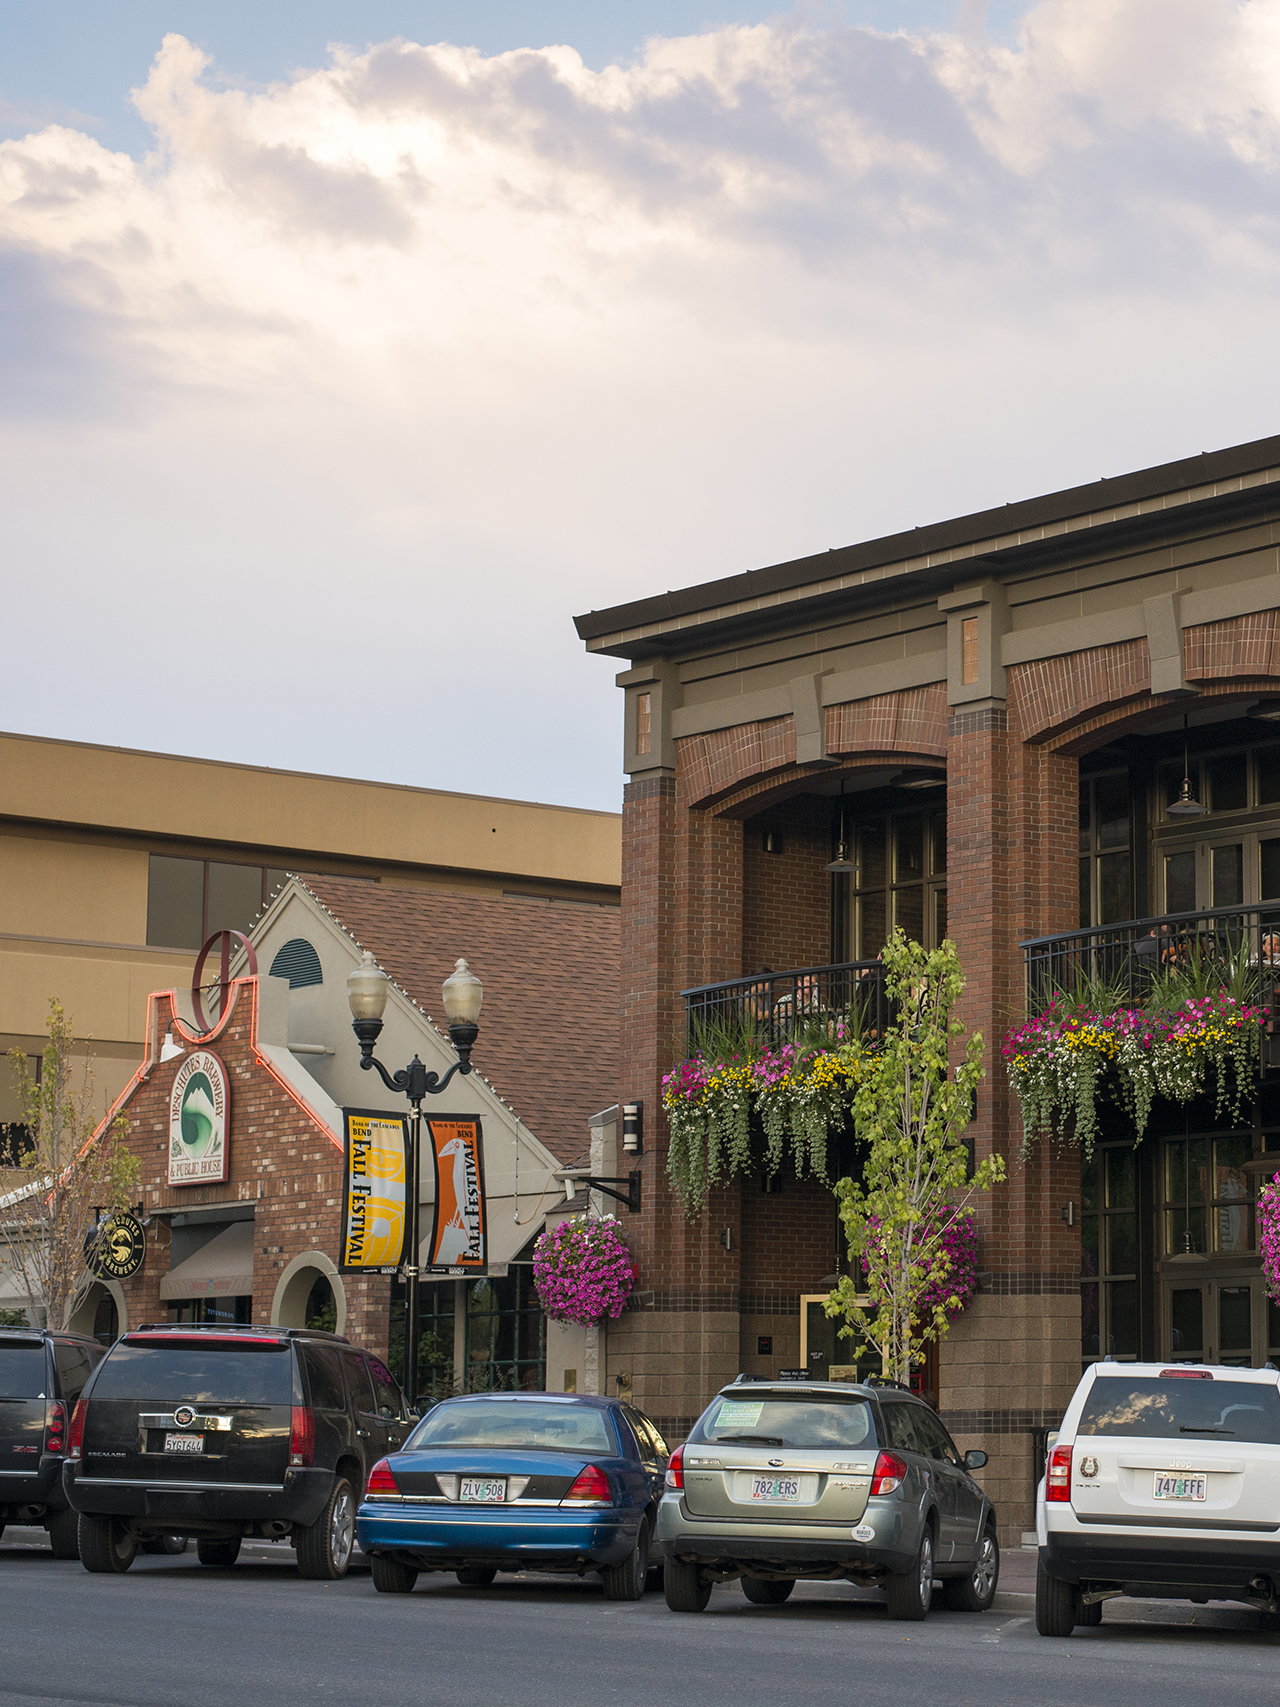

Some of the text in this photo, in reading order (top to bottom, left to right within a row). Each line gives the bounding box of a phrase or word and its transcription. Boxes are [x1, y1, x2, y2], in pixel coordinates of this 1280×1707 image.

[172, 1055, 223, 1121] DESCHUTES BREWERY
[353, 1128, 371, 1136] BEND
[457, 1130, 473, 1138] BEND
[170, 1159, 221, 1177] & PUBLIC HOUSE
[348, 1139, 371, 1264] FALL FESTIVAL
[462, 1140, 480, 1262] FALL FESTIVAL
[13, 1445, 38, 1453] GMC
[167, 1440, 201, 1450] 5YGT644
[1169, 1459, 1192, 1470] Jeep
[462, 1484, 503, 1496] ZLV 508
[755, 1480, 798, 1495] 782 ERS
[1157, 1477, 1204, 1494] 747 FFF
